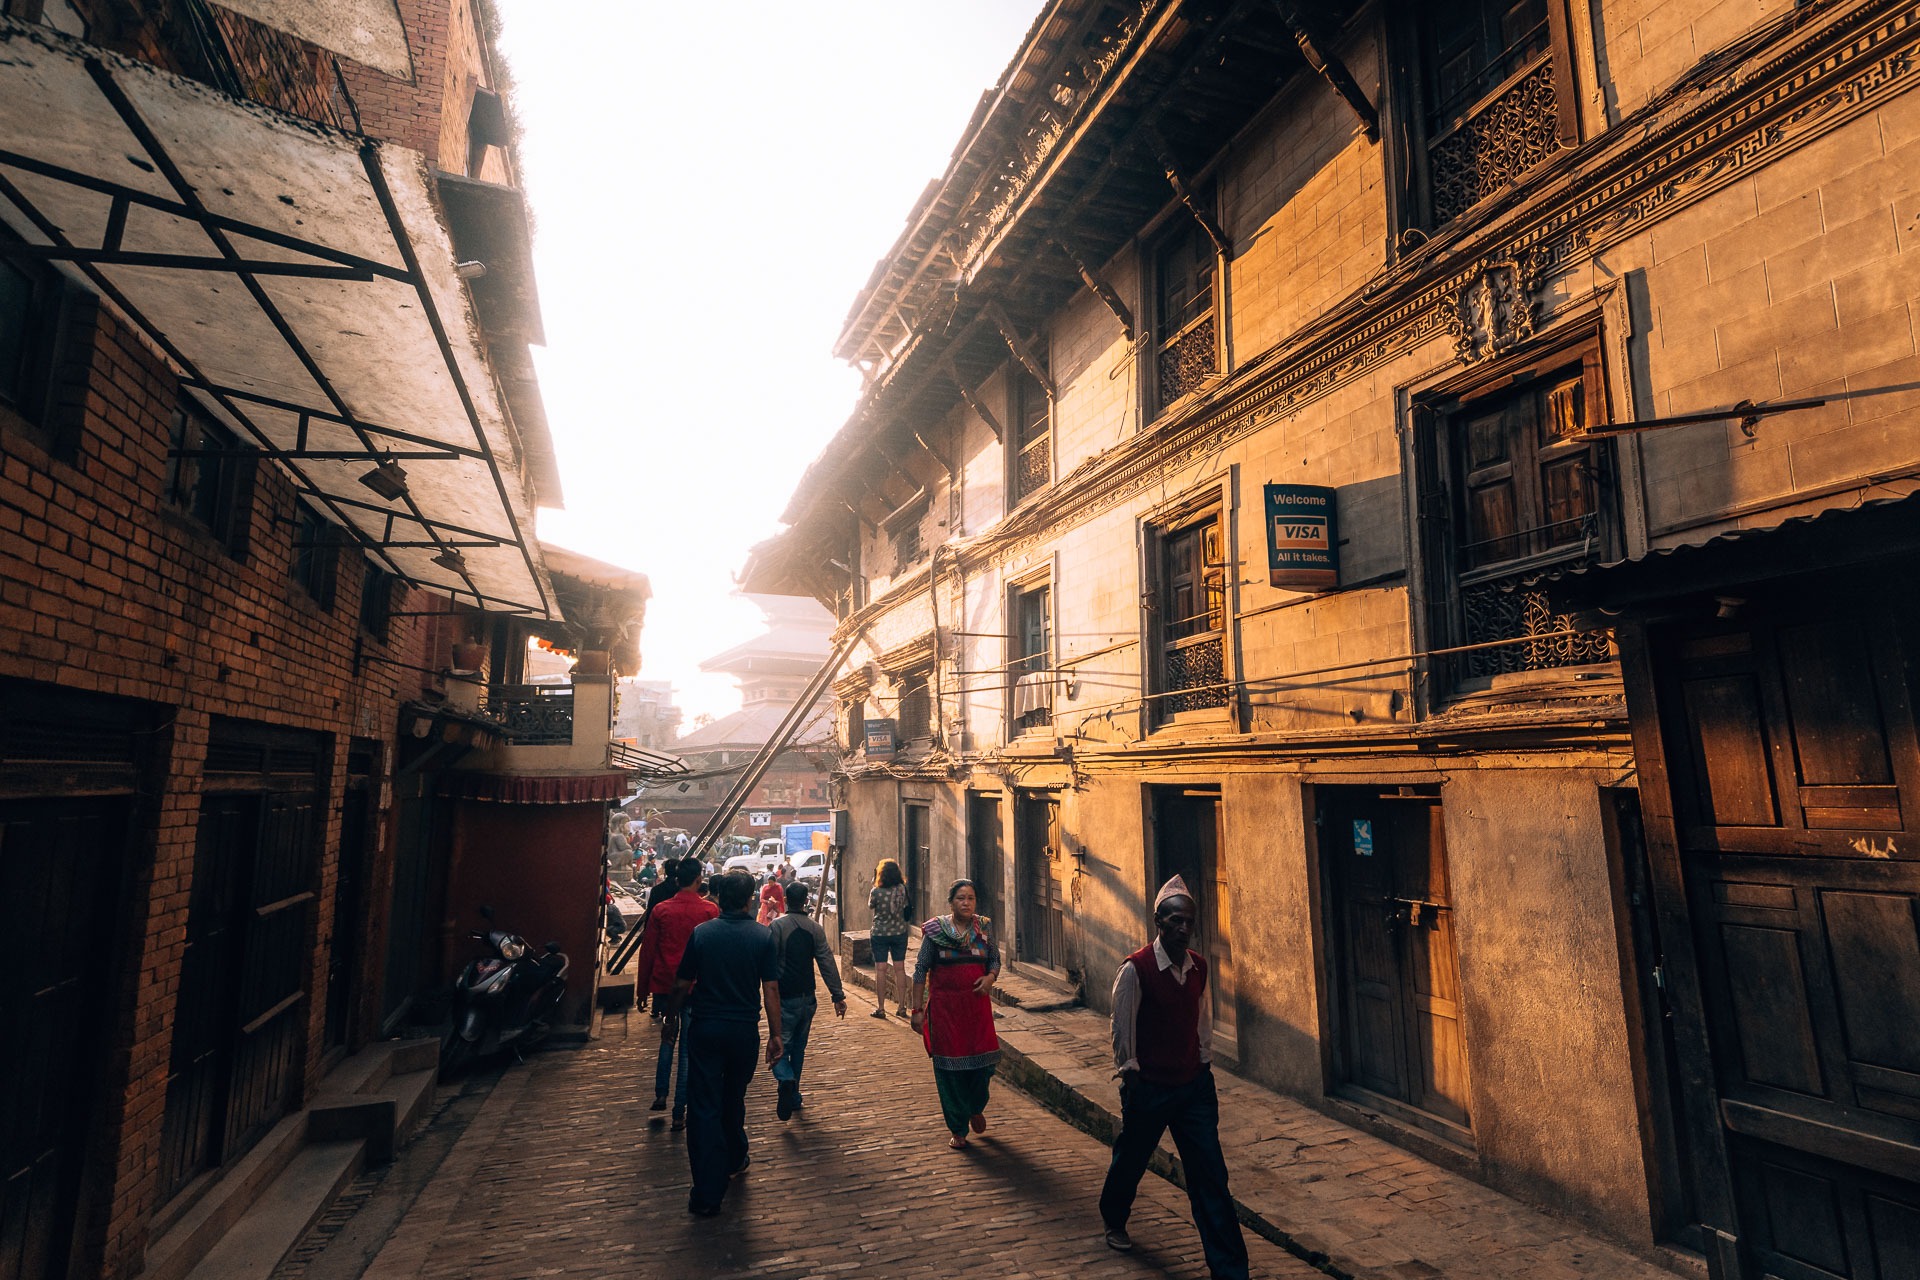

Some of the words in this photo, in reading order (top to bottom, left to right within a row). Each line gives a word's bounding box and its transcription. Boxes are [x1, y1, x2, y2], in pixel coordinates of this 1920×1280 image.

[1273, 494, 1326, 506] Welcome
[1284, 526, 1320, 538] VISA
[1277, 552, 1290, 562] All
[1293, 552, 1300, 562] it
[1302, 553, 1330, 562] takes.
